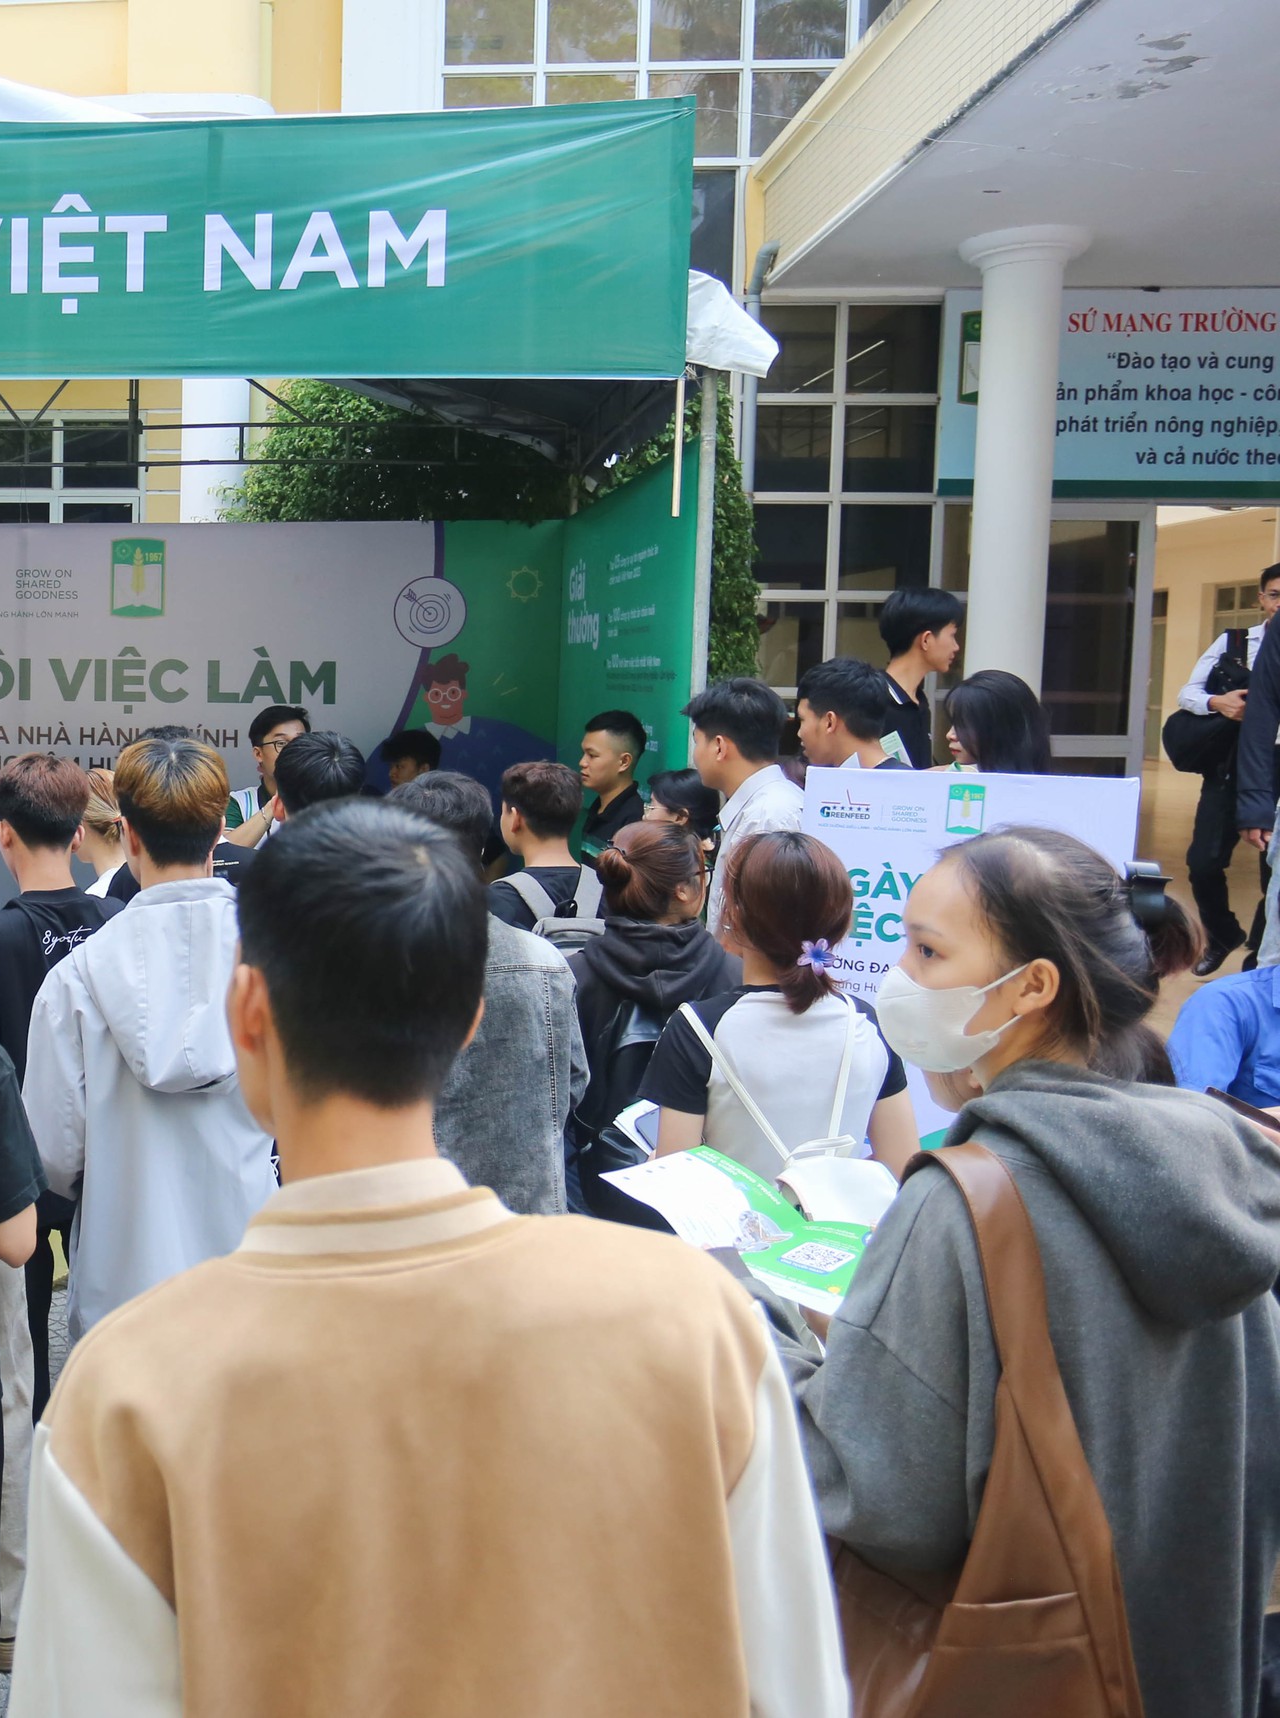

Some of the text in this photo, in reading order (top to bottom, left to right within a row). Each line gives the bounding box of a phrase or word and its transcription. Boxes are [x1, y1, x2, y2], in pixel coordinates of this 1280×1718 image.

[203, 208, 449, 293] NAM
[1067, 306, 1276, 338] SỨ MẠNG TRƯỜNG
[1161, 353, 1191, 376] tạo
[1197, 352, 1219, 370] và
[1225, 355, 1274, 375] cung
[1056, 379, 1280, 406] ản phẩm khoa học cô
[1055, 415, 1099, 437] phát
[1105, 411, 1148, 433] triển
[1155, 416, 1204, 437] nông
[1136, 447, 1280, 465] và cả nước the
[15, 569, 73, 578] GROW ON
[15, 579, 61, 589] SHARED
[15, 590, 79, 600] GOODNESS
[48, 646, 190, 715] VIỆC
[207, 647, 337, 706] LÀM
[17, 721, 71, 746] NHÀ
[196, 723, 239, 748] ÍNH
[819, 805, 870, 820] GREENFEED
[891, 816, 927, 824] GOODNESS
[847, 862, 924, 901] GÀY
[848, 902, 904, 947] ỆC
[832, 955, 865, 972] ỜNG
